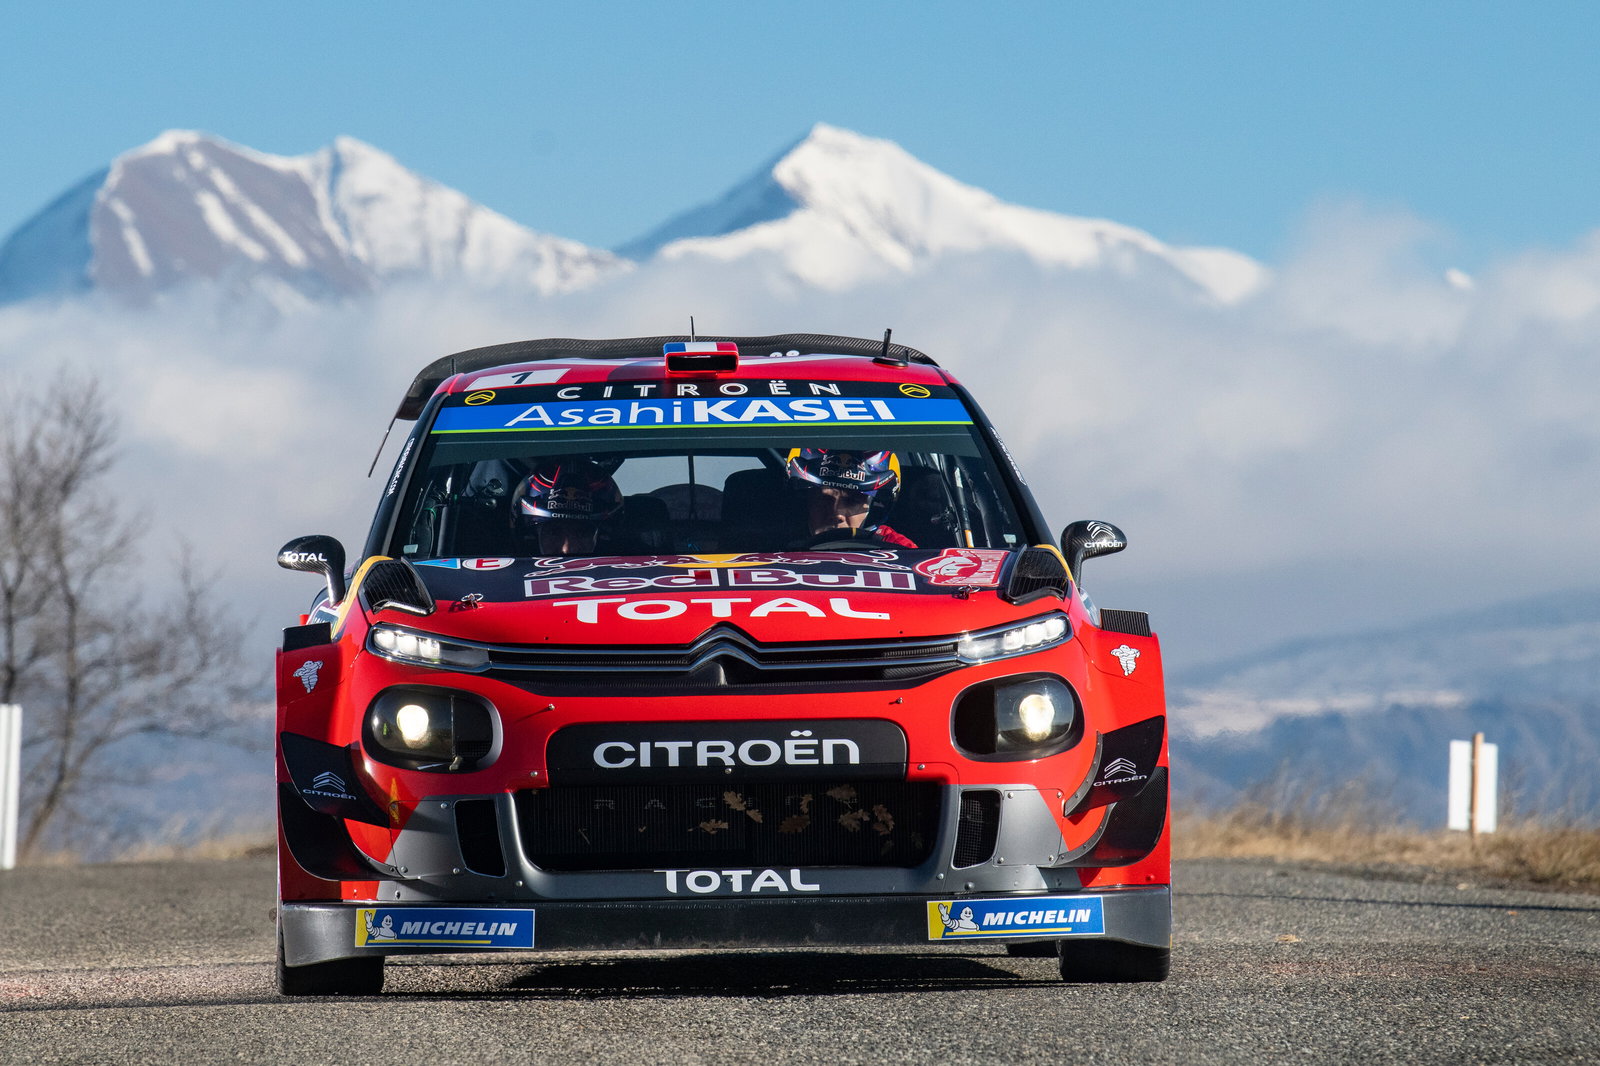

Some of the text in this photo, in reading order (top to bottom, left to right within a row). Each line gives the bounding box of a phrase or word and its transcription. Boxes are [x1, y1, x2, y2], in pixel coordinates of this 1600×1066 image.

[511, 371, 534, 385] 1
[557, 380, 841, 400] CITROËN
[282, 550, 328, 562] TOTAL
[524, 568, 917, 597] Red Bull
[552, 597, 891, 624] TOTAL
[592, 729, 860, 769] CITROËN
[653, 868, 820, 894] TOTAL
[982, 908, 1092, 926] MICHELIN
[400, 921, 518, 936] MICHELIN
